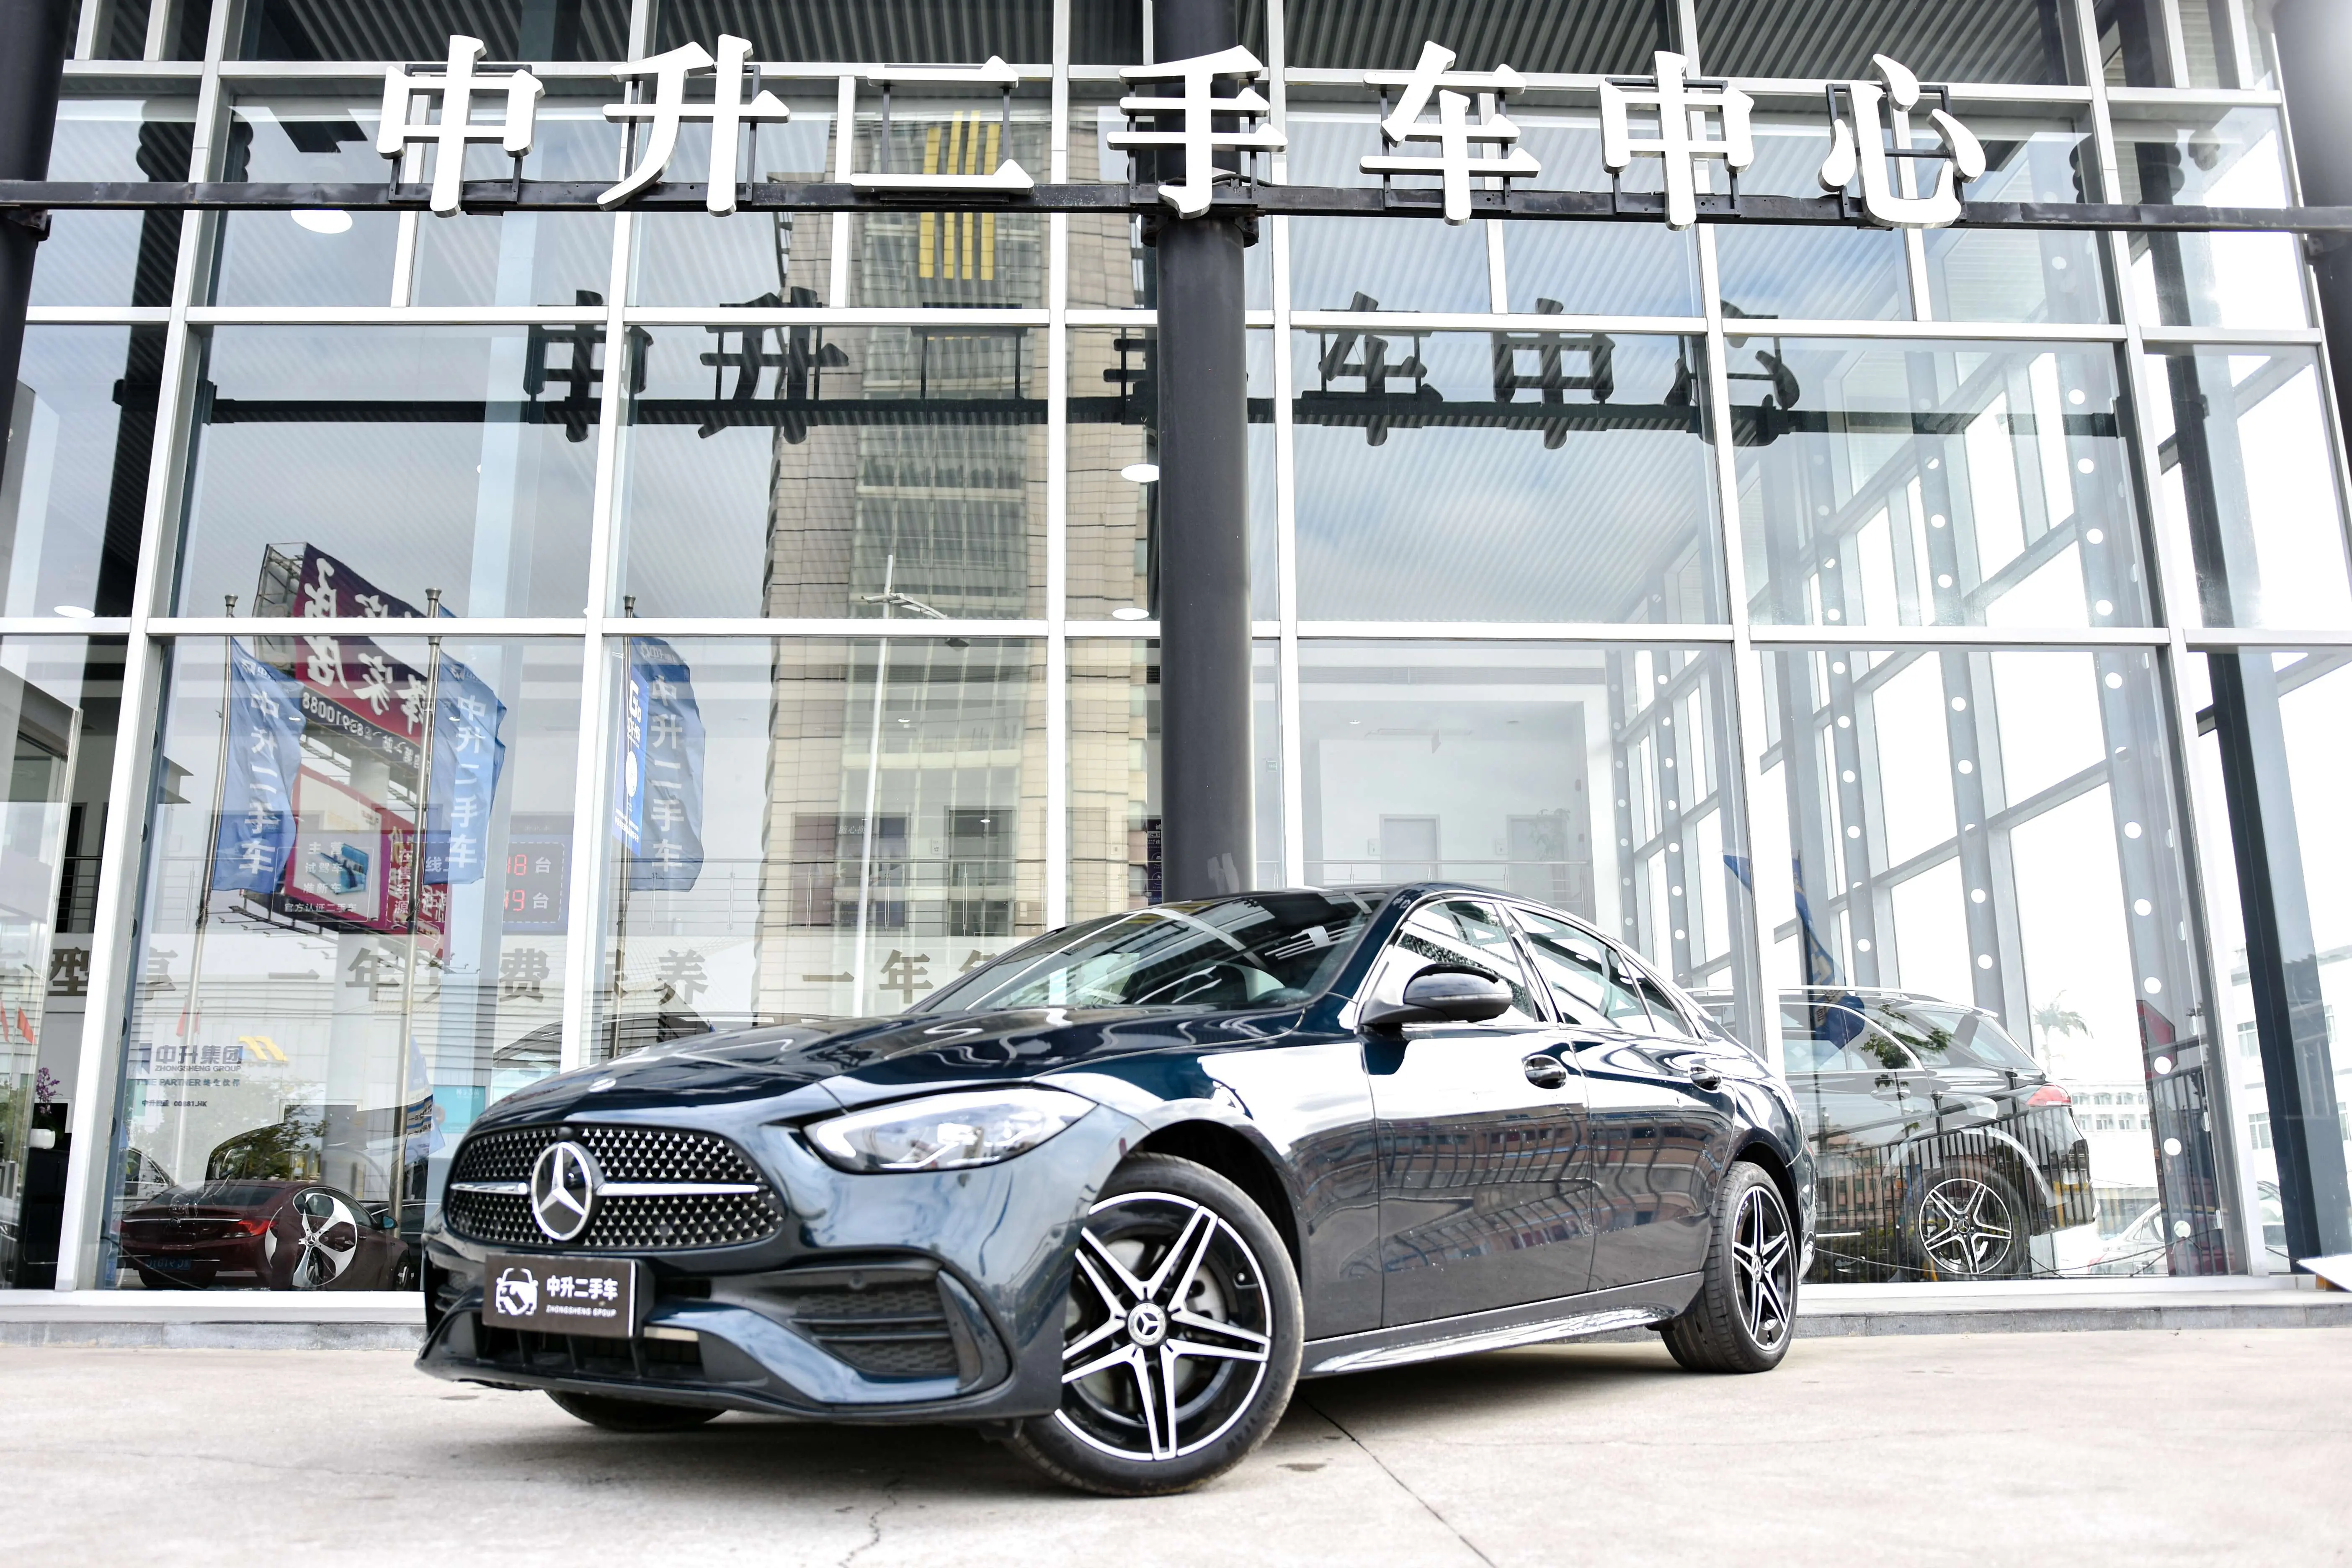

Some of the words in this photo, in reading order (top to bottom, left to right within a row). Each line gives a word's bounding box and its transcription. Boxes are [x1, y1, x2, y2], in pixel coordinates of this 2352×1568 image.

[375, 34, 1986, 231] 中升二手车中心
[449, 695, 486, 869] 中升二手车
[651, 675, 684, 873] 中升二手车
[305, 862, 345, 874] 试驾车
[535, 856, 552, 874] 台
[395, 849, 413, 914] 在售车源
[284, 903, 357, 913] 官方认证二手车
[533, 892, 549, 909] 台
[155, 1045, 243, 1064] 中升集团
[546, 1274, 619, 1301] 中升二手车
